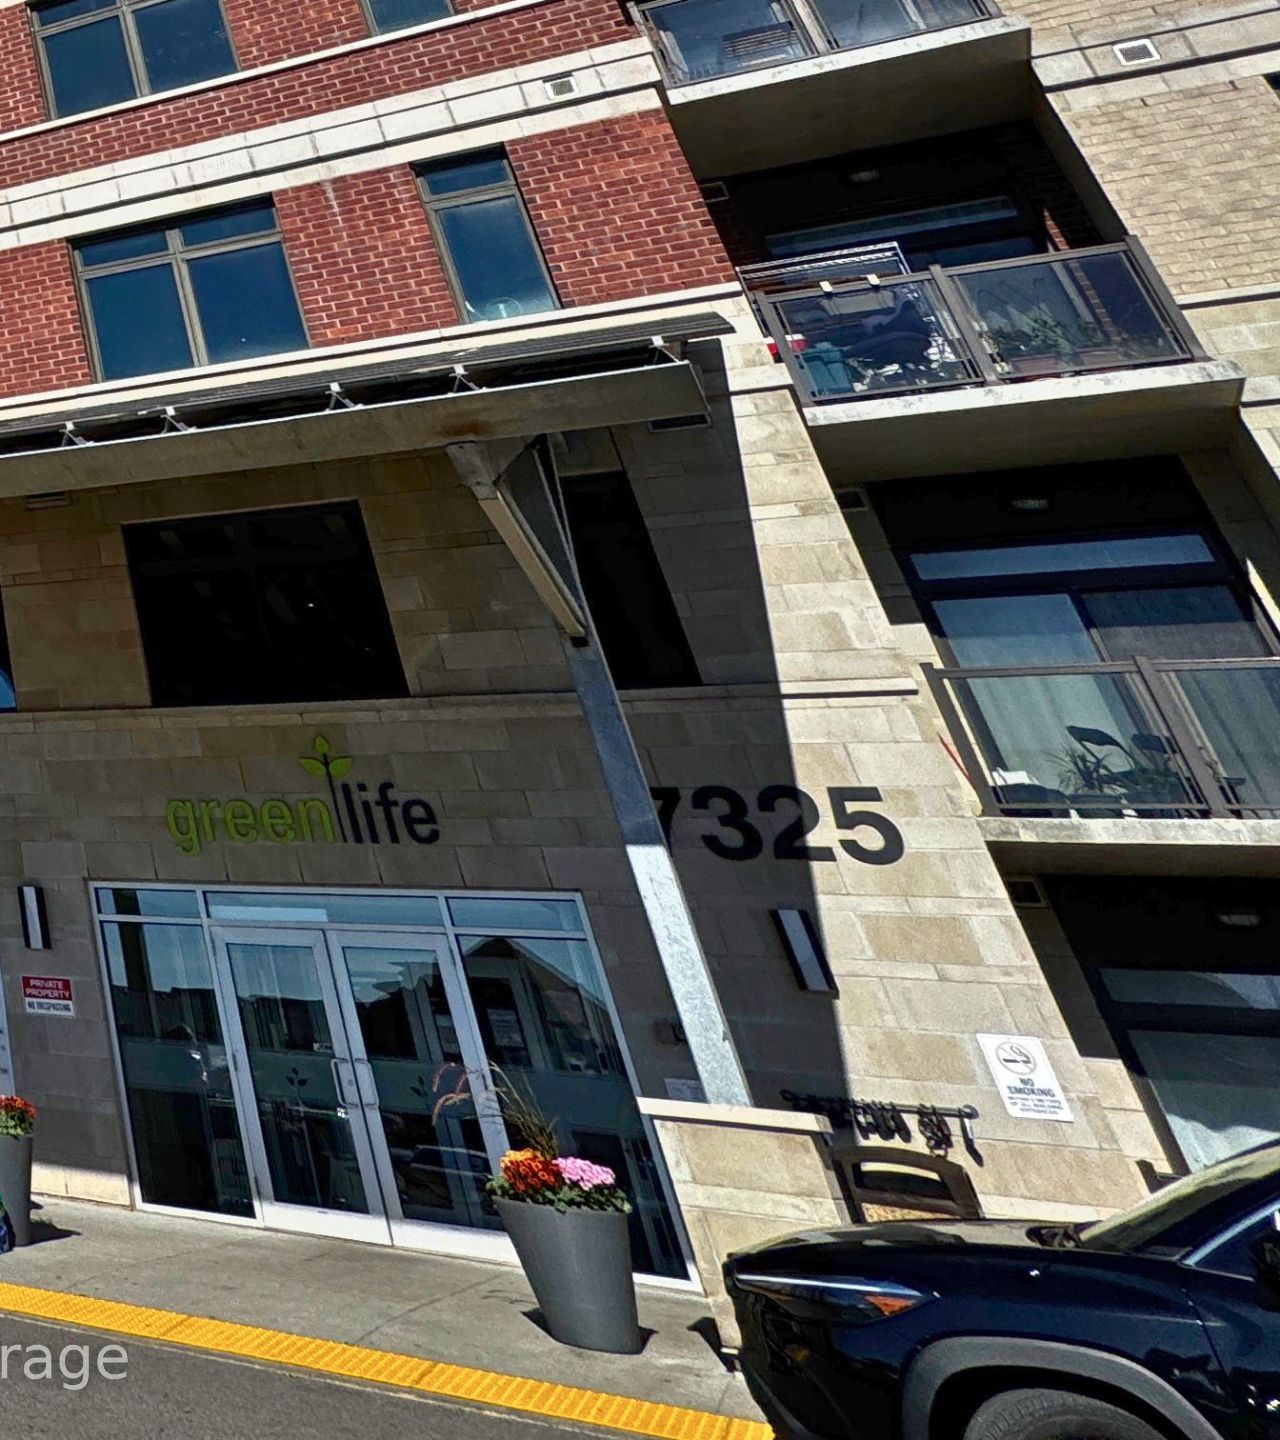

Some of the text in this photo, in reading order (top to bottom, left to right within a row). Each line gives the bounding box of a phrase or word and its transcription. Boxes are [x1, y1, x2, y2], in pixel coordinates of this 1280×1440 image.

[30, 979, 64, 990] PRIVATE
[25, 987, 70, 999] PROPERTY
[1019, 1077, 1035, 1088] NO
[1007, 1085, 1057, 1098] SMOKING
